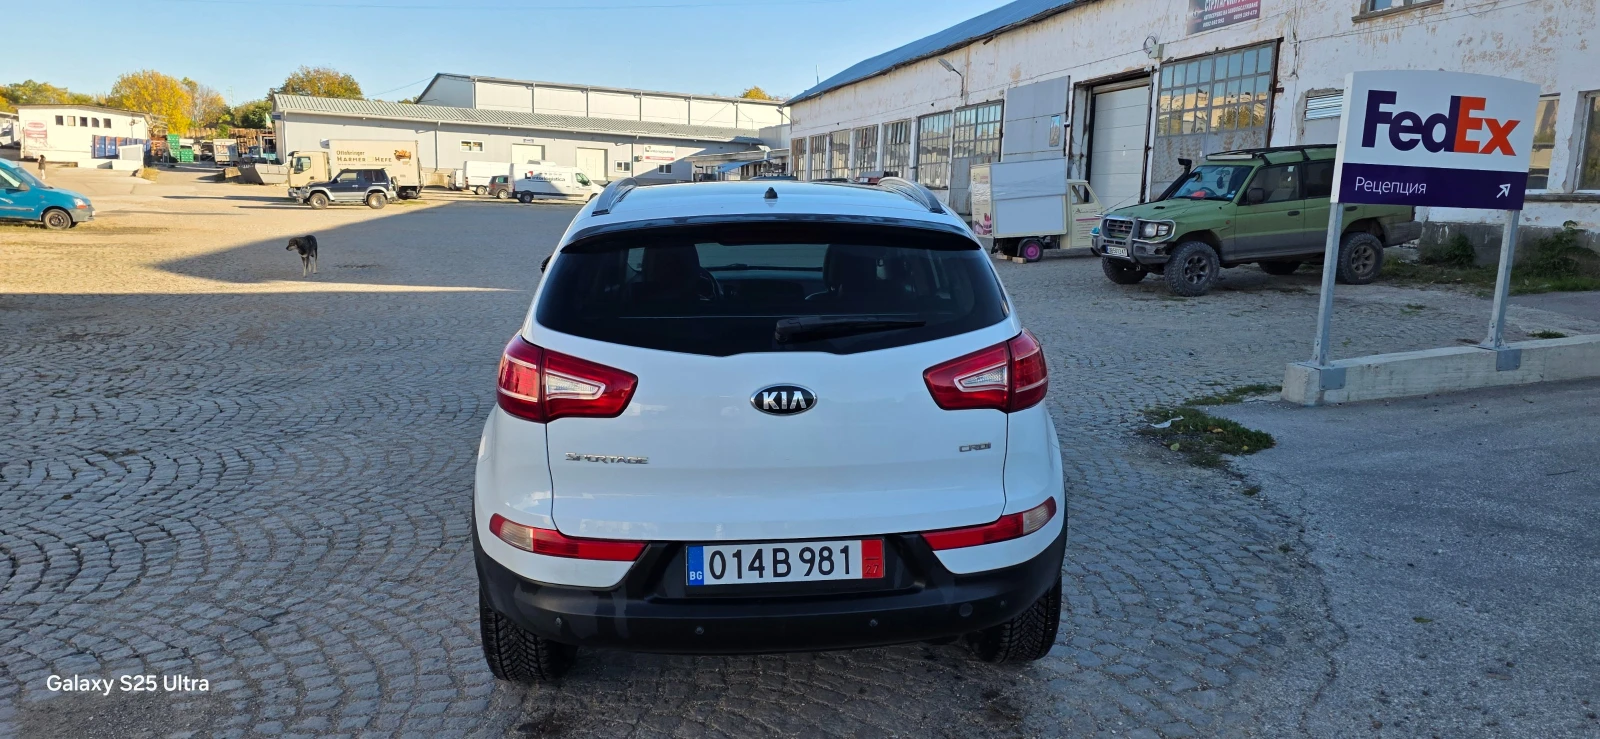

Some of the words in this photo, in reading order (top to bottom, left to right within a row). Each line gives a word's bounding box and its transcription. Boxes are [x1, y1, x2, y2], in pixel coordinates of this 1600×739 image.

[1361, 89, 1521, 156] FedEx
[1355, 176, 1427, 196] Рецепция
[762, 390, 807, 410] KIA
[565, 452, 649, 464] SPORTAGE
[689, 571, 703, 581] BG
